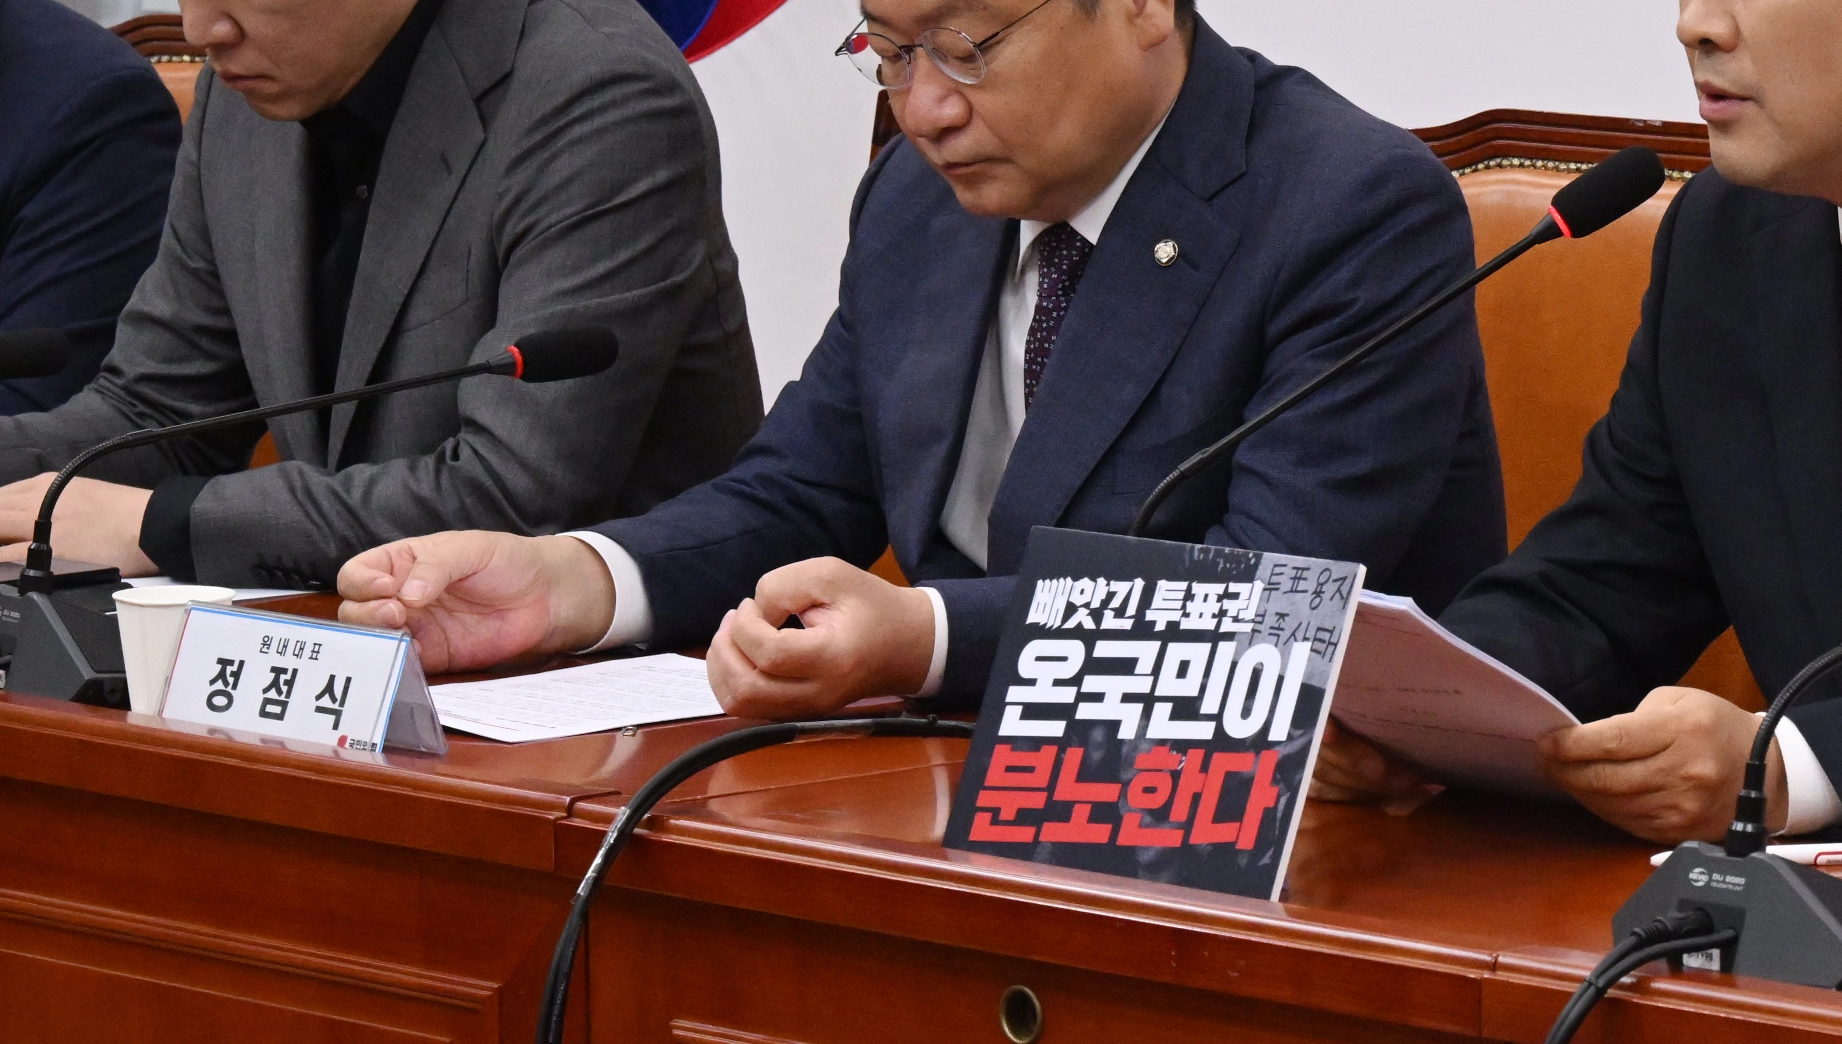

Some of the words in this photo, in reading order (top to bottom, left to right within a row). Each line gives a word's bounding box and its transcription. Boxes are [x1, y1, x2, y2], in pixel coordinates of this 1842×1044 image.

[1025, 577, 1145, 630] 빼앗긴
[1144, 579, 1265, 634] 투표권
[1263, 563, 1358, 611] 투표용지
[259, 635, 323, 661] 원내대표
[206, 657, 353, 731] 정점식
[968, 744, 1281, 850] 분노한다
